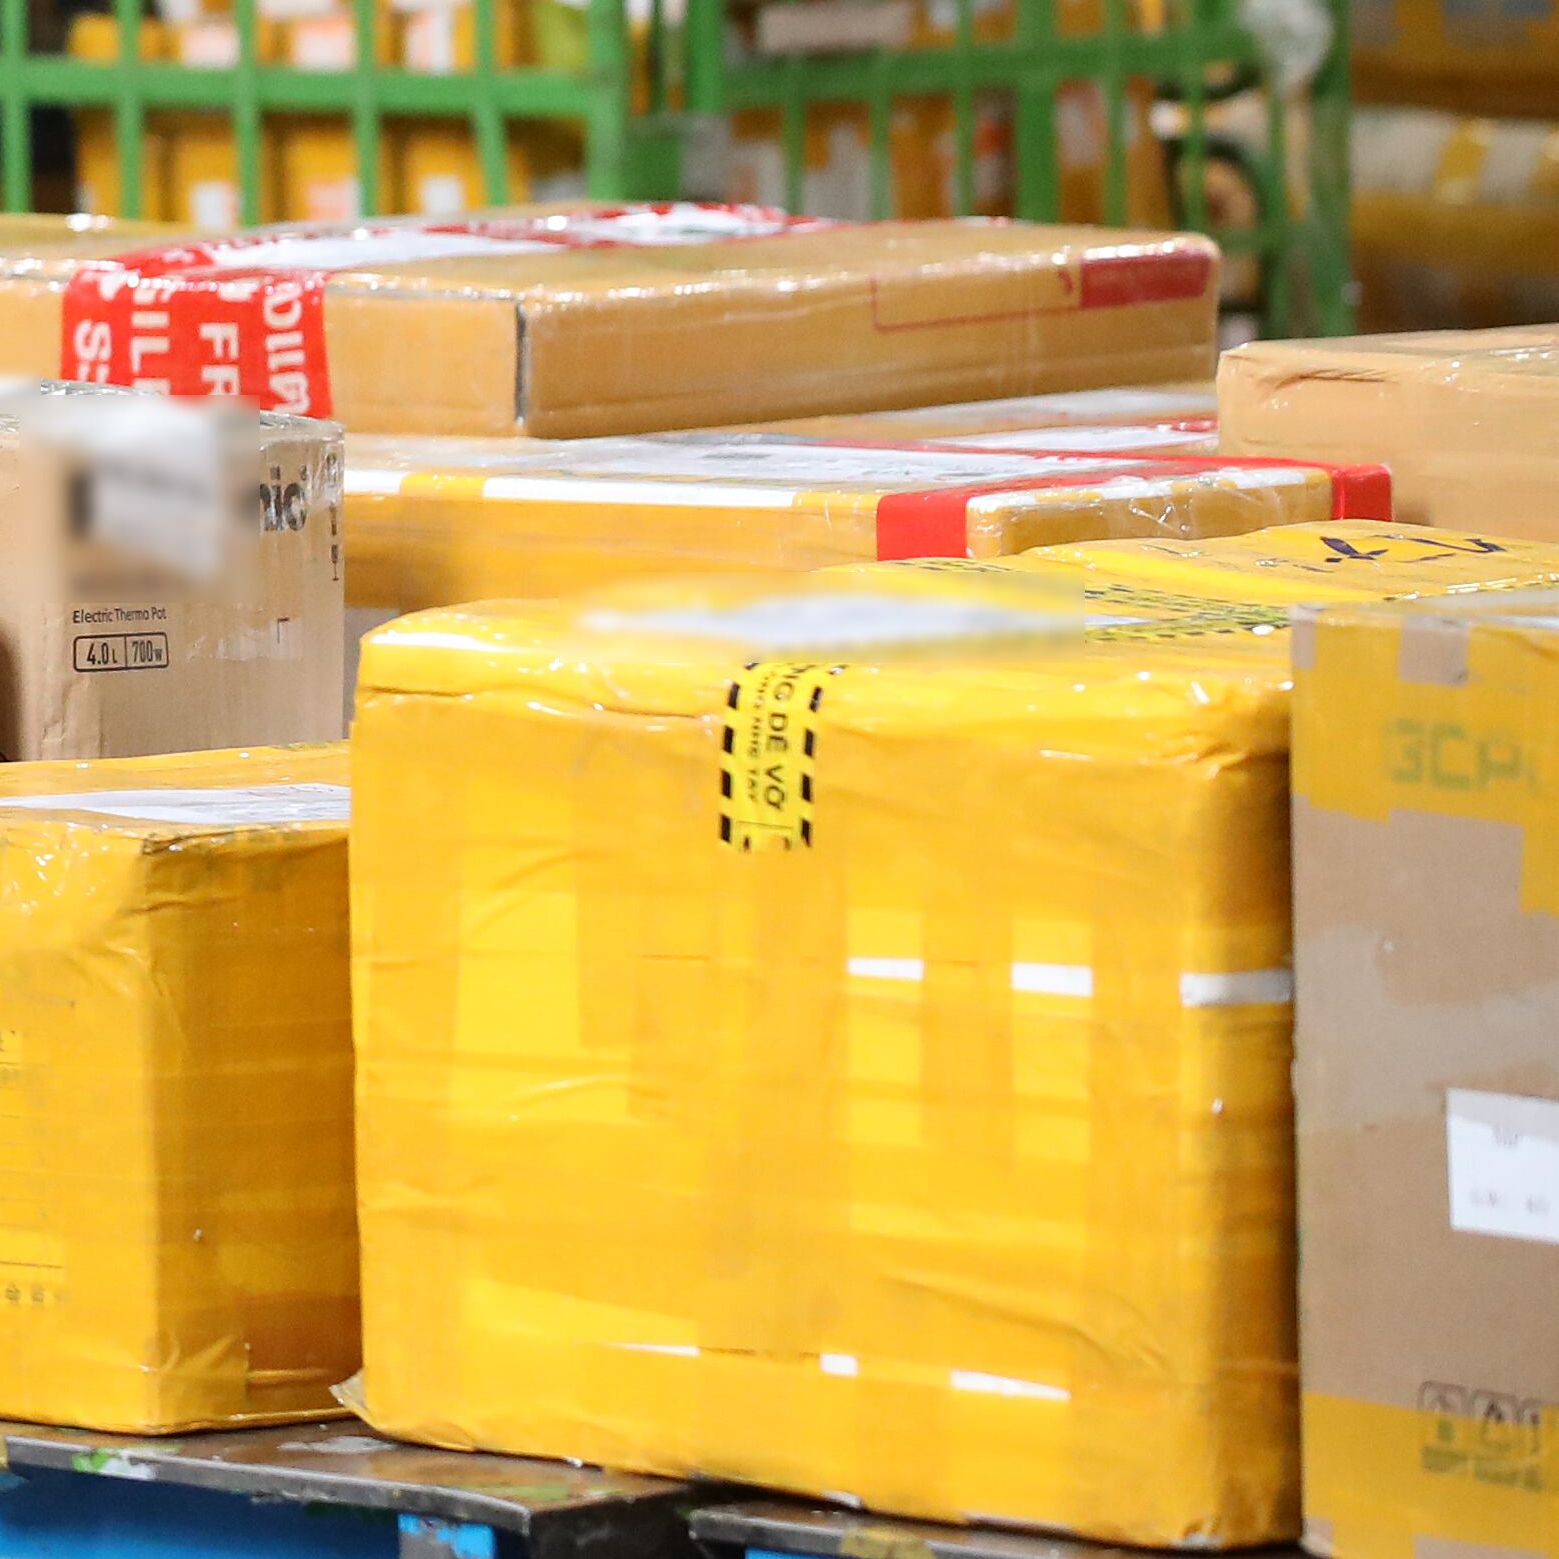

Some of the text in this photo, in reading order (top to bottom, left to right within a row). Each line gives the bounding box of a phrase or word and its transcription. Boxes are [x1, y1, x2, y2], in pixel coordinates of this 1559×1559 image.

[72, 607, 167, 624] Electric Thermo Pot
